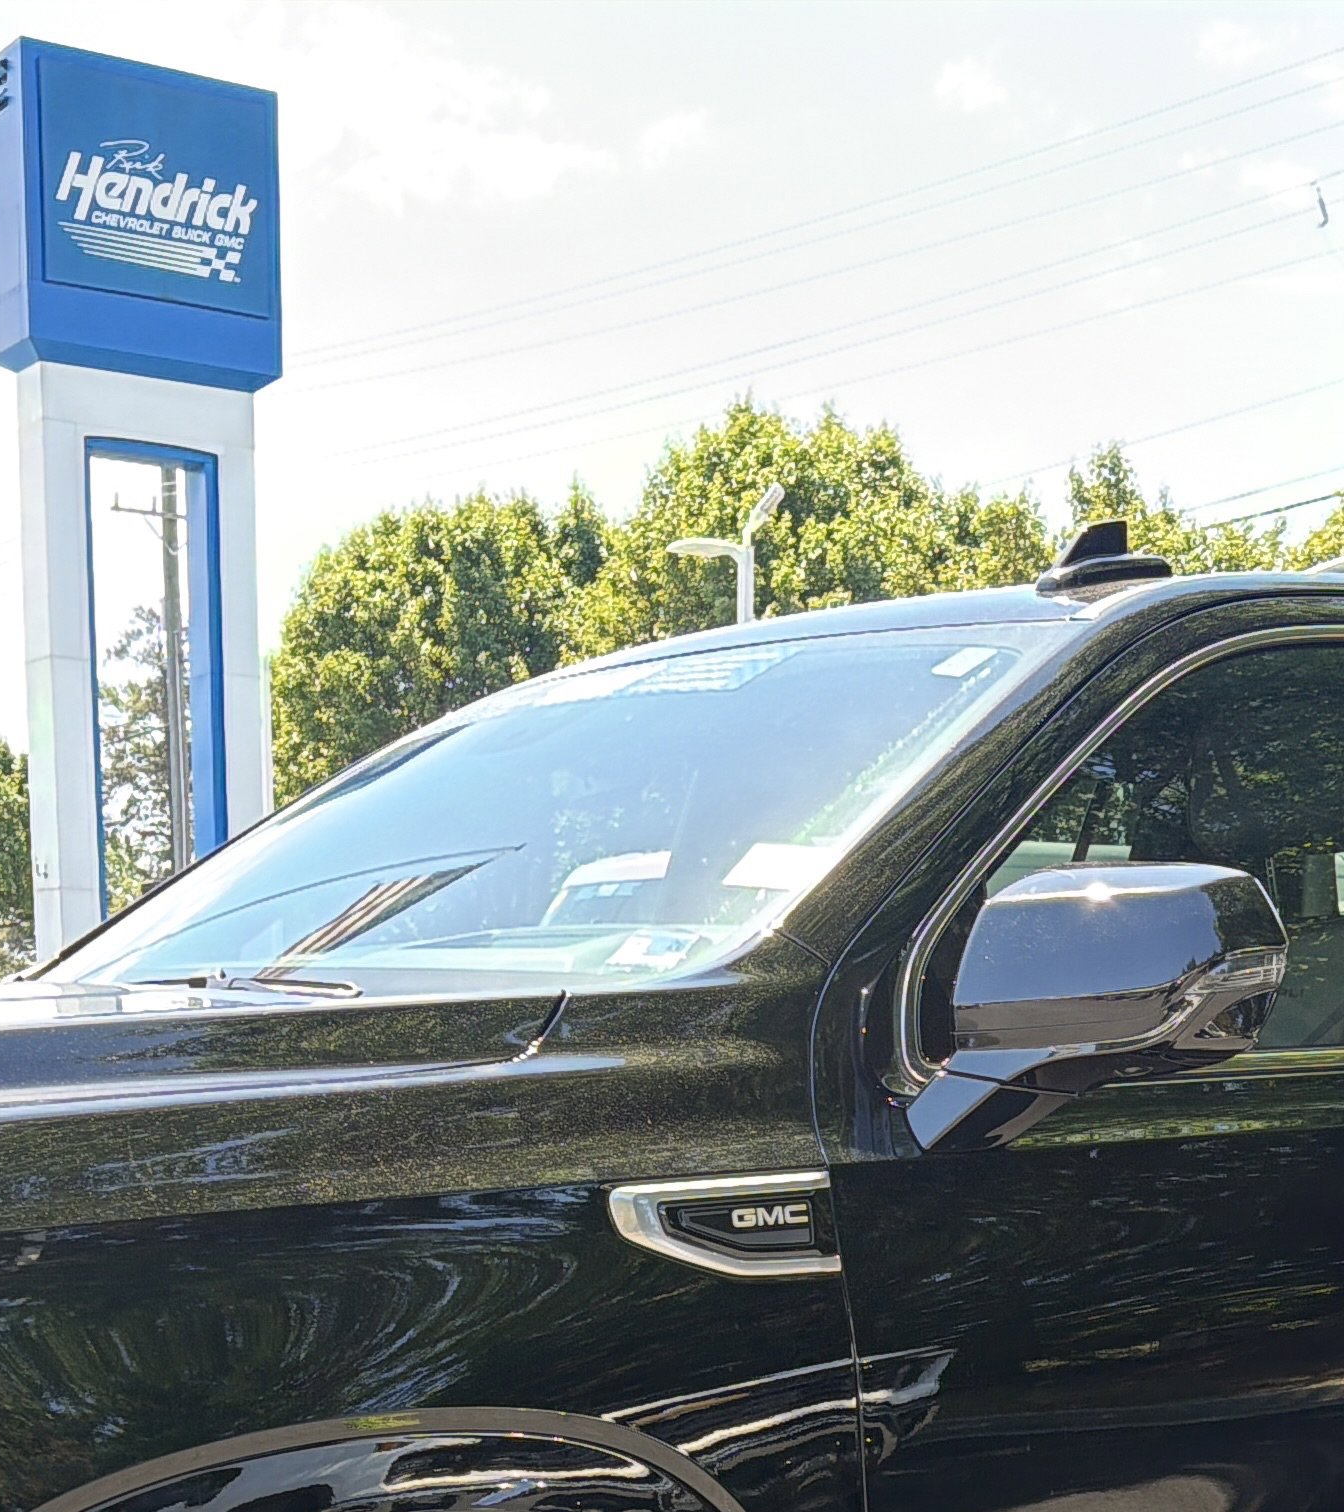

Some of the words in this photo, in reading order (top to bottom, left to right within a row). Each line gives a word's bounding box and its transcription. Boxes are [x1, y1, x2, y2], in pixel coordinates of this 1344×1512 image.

[56, 151, 258, 235] Hendrick
[90, 210, 171, 237] CHEVROLET
[171, 225, 213, 246] BUICK
[213, 233, 245, 251] GMC
[730, 1203, 810, 1229] GMC
